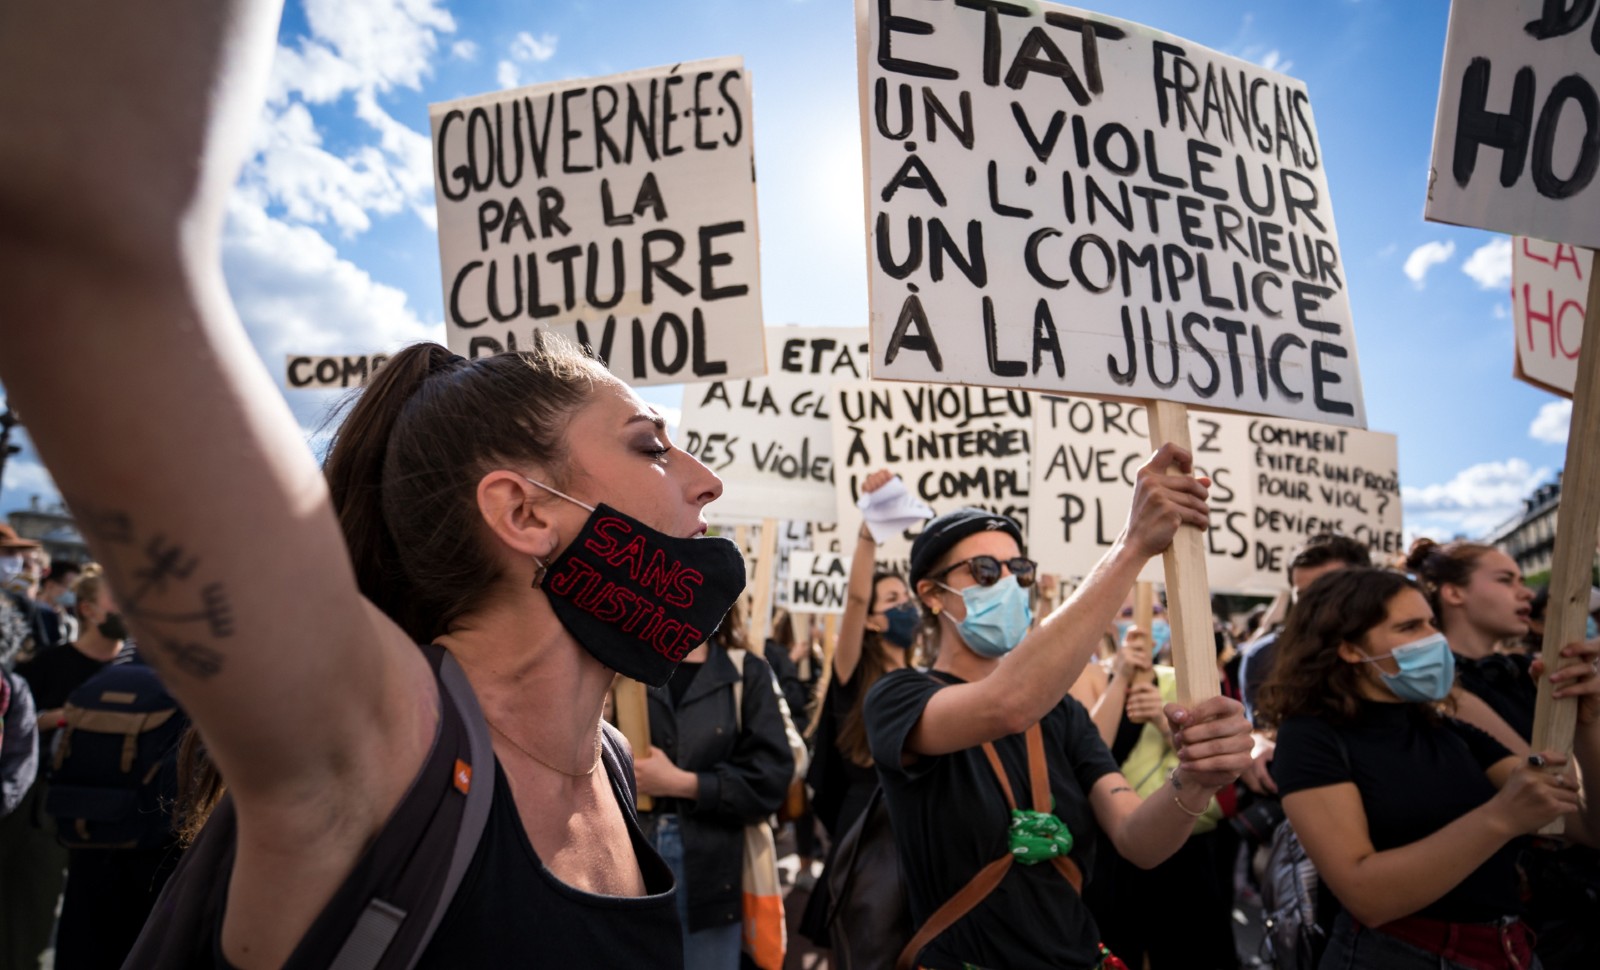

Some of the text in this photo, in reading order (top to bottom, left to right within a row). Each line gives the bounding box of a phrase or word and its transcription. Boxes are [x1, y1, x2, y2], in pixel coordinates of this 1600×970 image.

[1152, 40, 1319, 170] FRANÇAIS
[875, 77, 1327, 233] UN VIOLEUR
[478, 171, 668, 252] PAR LA
[987, 160, 1343, 289] L'INTERIEUR
[449, 220, 749, 329] CULTURE
[875, 211, 1344, 335] UN COMPLICE
[576, 307, 728, 379] VIOL
[982, 295, 1066, 380] LA
[1107, 305, 1355, 418] JUSTICE
[741, 379, 781, 416] LA
[840, 388, 894, 423] UN
[685, 430, 739, 472] DES
[1248, 420, 1348, 454] COMMENT
[917, 466, 1029, 502] COMPL
[1044, 444, 1142, 488] AVEC
[1324, 462, 1350, 484] UN
[1258, 473, 1313, 503] POUR
[1375, 492, 1390, 524] ?
[584, 516, 704, 609] SANS
[811, 555, 846, 577] LA
[1255, 541, 1283, 572] DE
